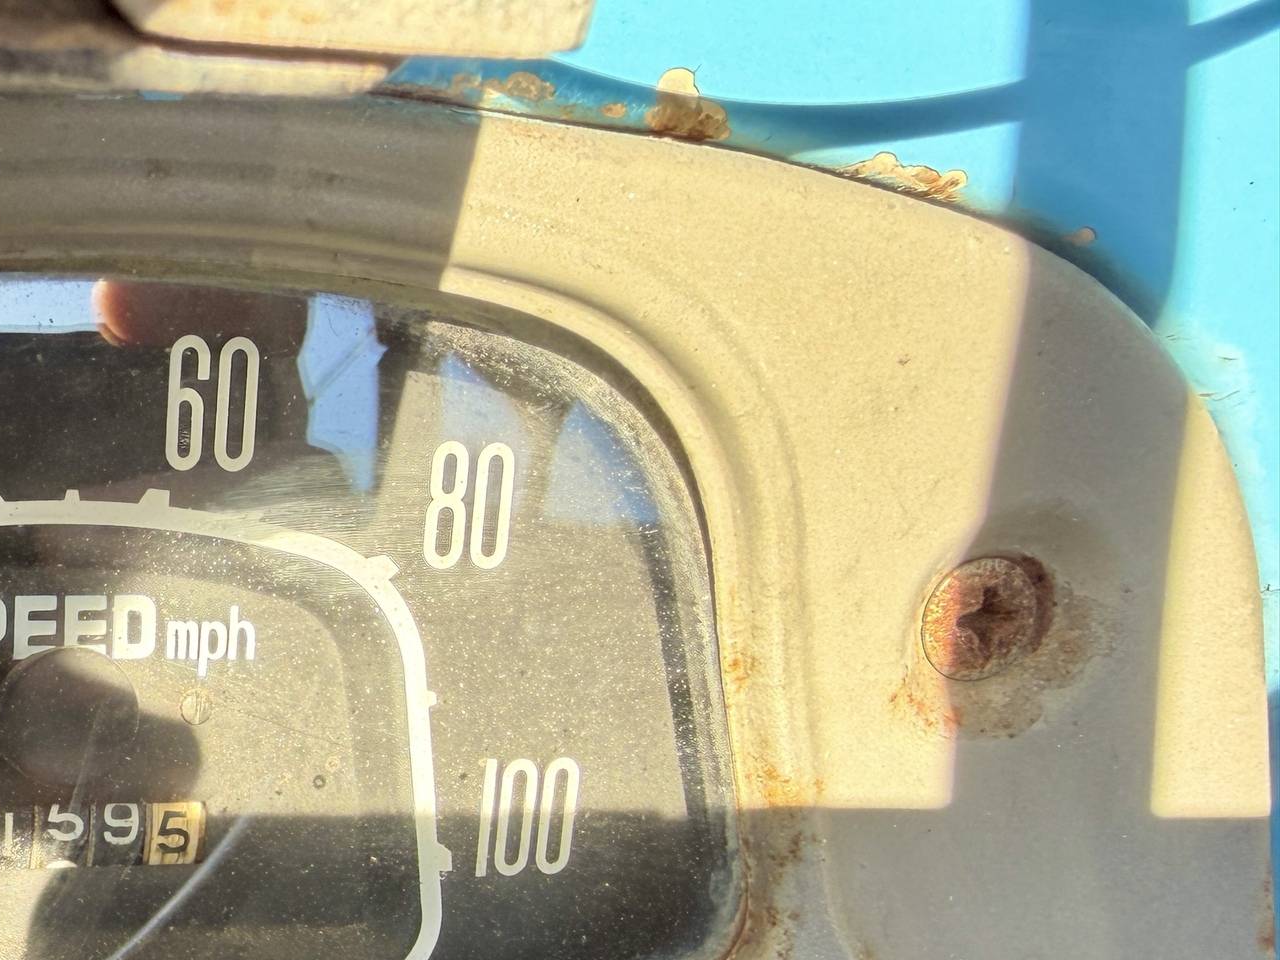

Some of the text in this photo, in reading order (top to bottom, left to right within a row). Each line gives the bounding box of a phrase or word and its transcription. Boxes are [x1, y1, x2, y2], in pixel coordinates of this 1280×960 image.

[166, 334, 260, 472] 60
[423, 440, 516, 571] 80
[166, 605, 256, 679] mph
[475, 757, 581, 878] 100
